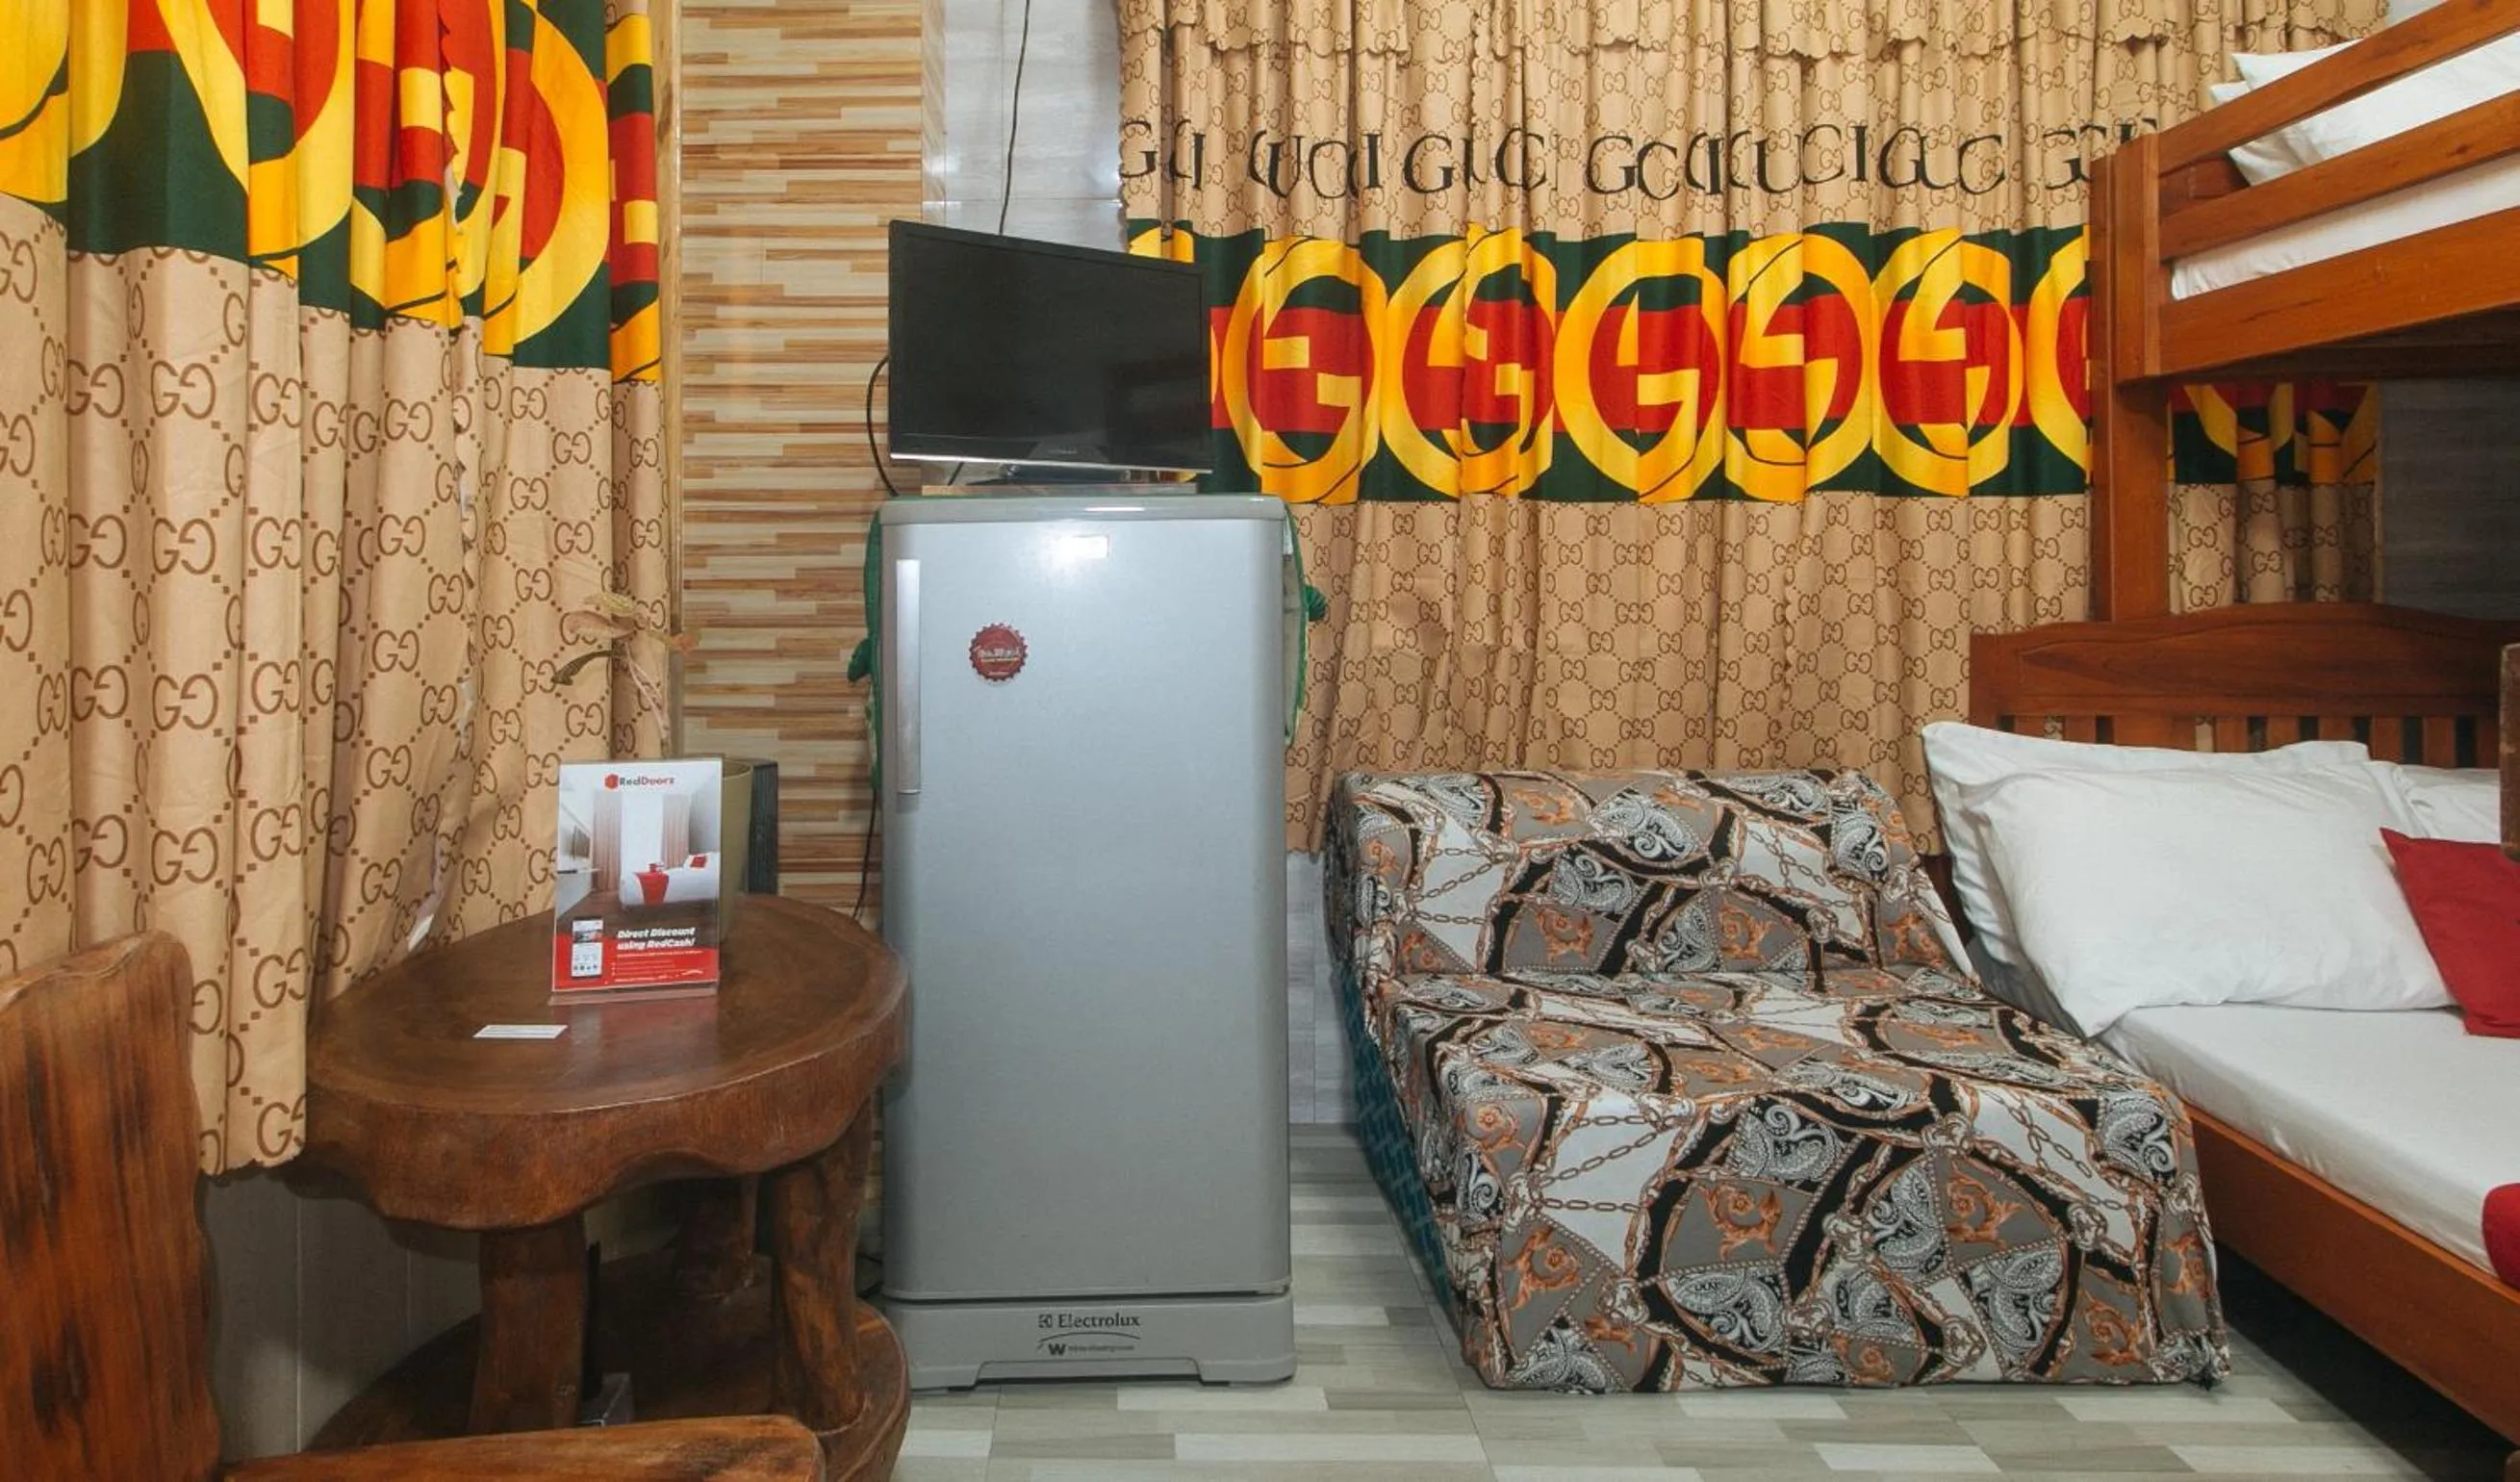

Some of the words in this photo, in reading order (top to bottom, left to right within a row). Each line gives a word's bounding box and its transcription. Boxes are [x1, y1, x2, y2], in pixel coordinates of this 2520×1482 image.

[617, 930, 649, 938] Direct
[649, 928, 696, 937] Discount
[617, 940, 647, 950] using
[1058, 1313, 1141, 1328] Electrolux
